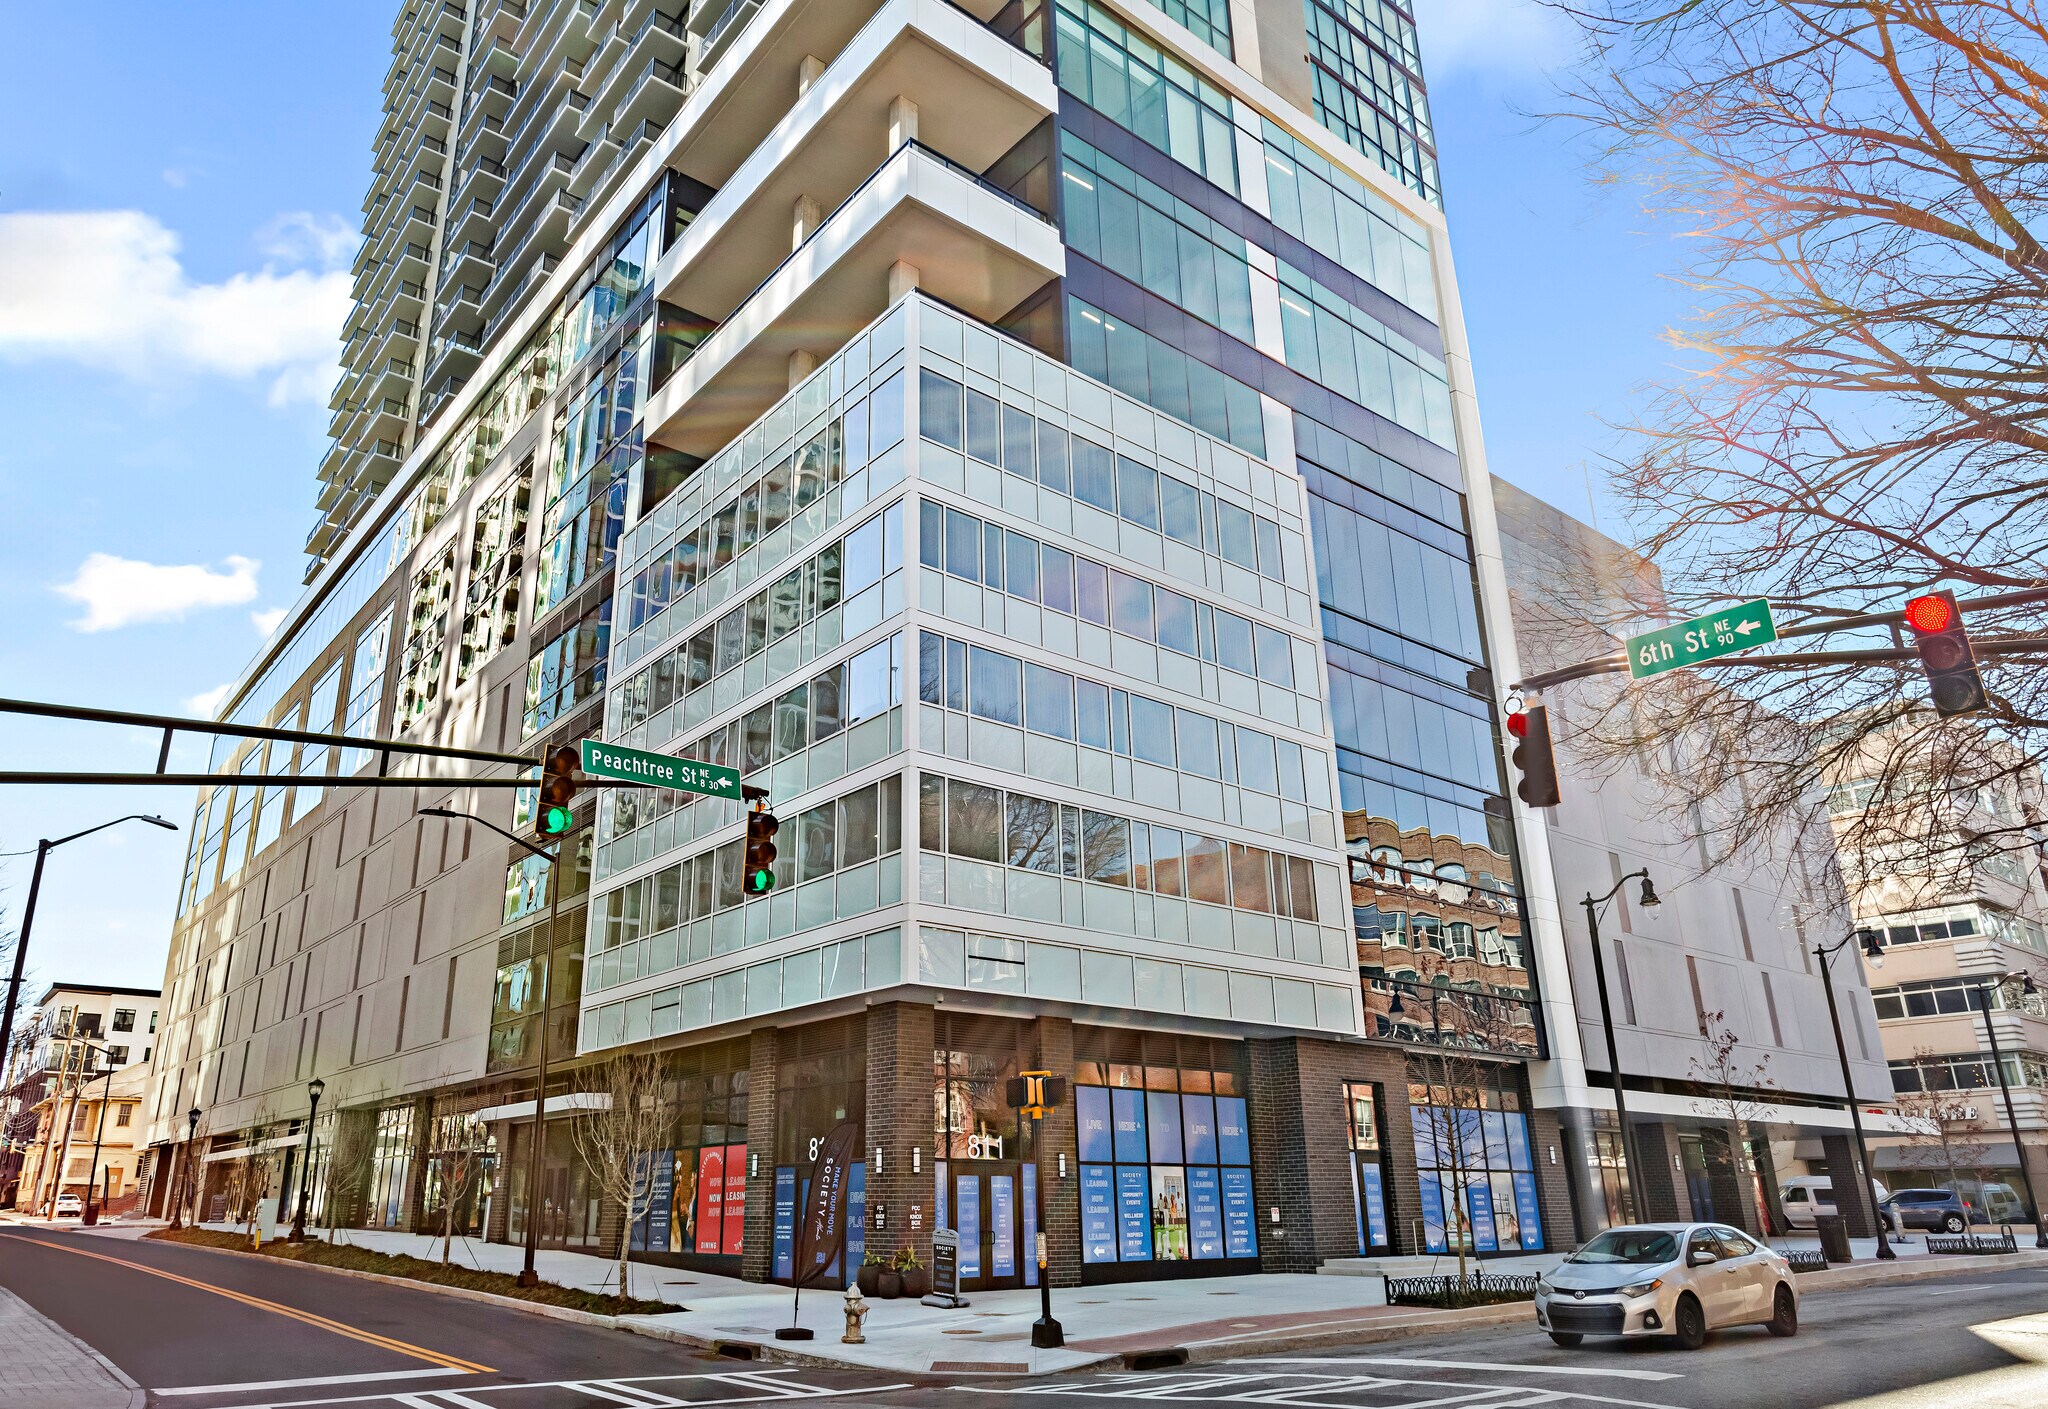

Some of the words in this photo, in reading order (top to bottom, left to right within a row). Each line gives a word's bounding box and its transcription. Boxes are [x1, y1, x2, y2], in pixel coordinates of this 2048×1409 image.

[1713, 619, 1731, 634] NE
[1717, 633, 1734, 647] 90
[1639, 640, 1674, 666] 6th
[1684, 629, 1709, 653] St
[592, 749, 674, 780] Peachtree
[681, 766, 697, 785] St
[699, 768, 710, 779] NE
[1086, 1119, 1102, 1130] LIVE
[1118, 1121, 1136, 1132] HERE
[1192, 1124, 1207, 1135] LIVE
[1222, 1126, 1239, 1137] HERE
[968, 1134, 1003, 1159] 811
[701, 1151, 723, 1178] ENTERTAINMENT
[833, 1166, 841, 1189] MAKE
[1090, 1168, 1102, 1176] NOW
[1196, 1170, 1208, 1178] NOW
[727, 1176, 746, 1186] LEASIN
[818, 1157, 834, 1217] SOCIETY
[708, 1193, 721, 1202] NOW
[726, 1191, 746, 1201] LEASIN
[829, 1189, 837, 1212] YOUR
[1091, 1195, 1104, 1203] NOW
[725, 1206, 745, 1216] LEASIN
[1194, 1205, 1216, 1213] LEASING
[826, 1212, 835, 1236] MOVE
[848, 1216, 865, 1228] PLA
[1088, 1232, 1110, 1240] LEASING
[848, 1240, 865, 1253] SHO
